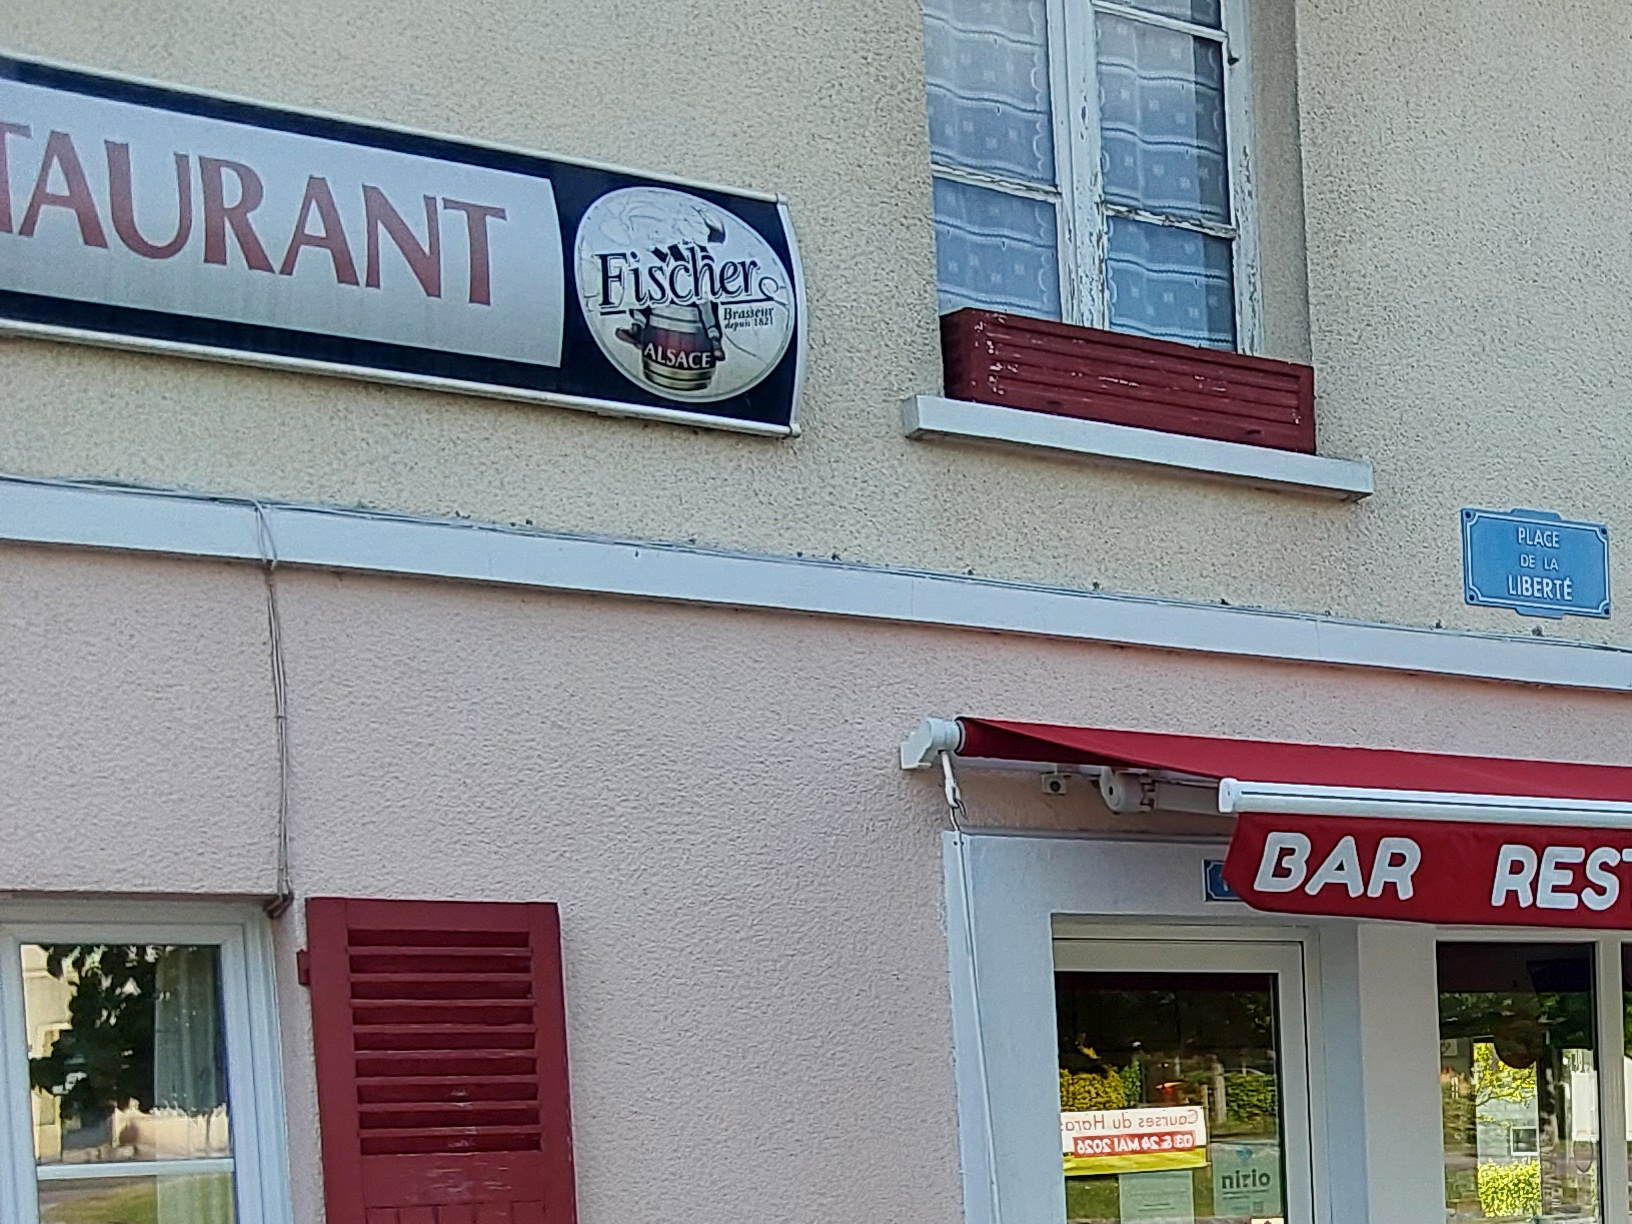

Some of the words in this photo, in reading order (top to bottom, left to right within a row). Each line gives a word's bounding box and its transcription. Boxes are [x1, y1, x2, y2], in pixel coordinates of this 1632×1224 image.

[595, 246, 761, 308] Fischer
[724, 307, 774, 321] Brasseur
[754, 316, 773, 327] 1821
[644, 343, 712, 369] ALSACE
[1518, 527, 1560, 548] PLACE
[1520, 554, 1535, 568] DE
[1544, 556, 1559, 571] LA
[1508, 574, 1573, 600] LIBERTÉ
[1254, 832, 1421, 899] BAR
